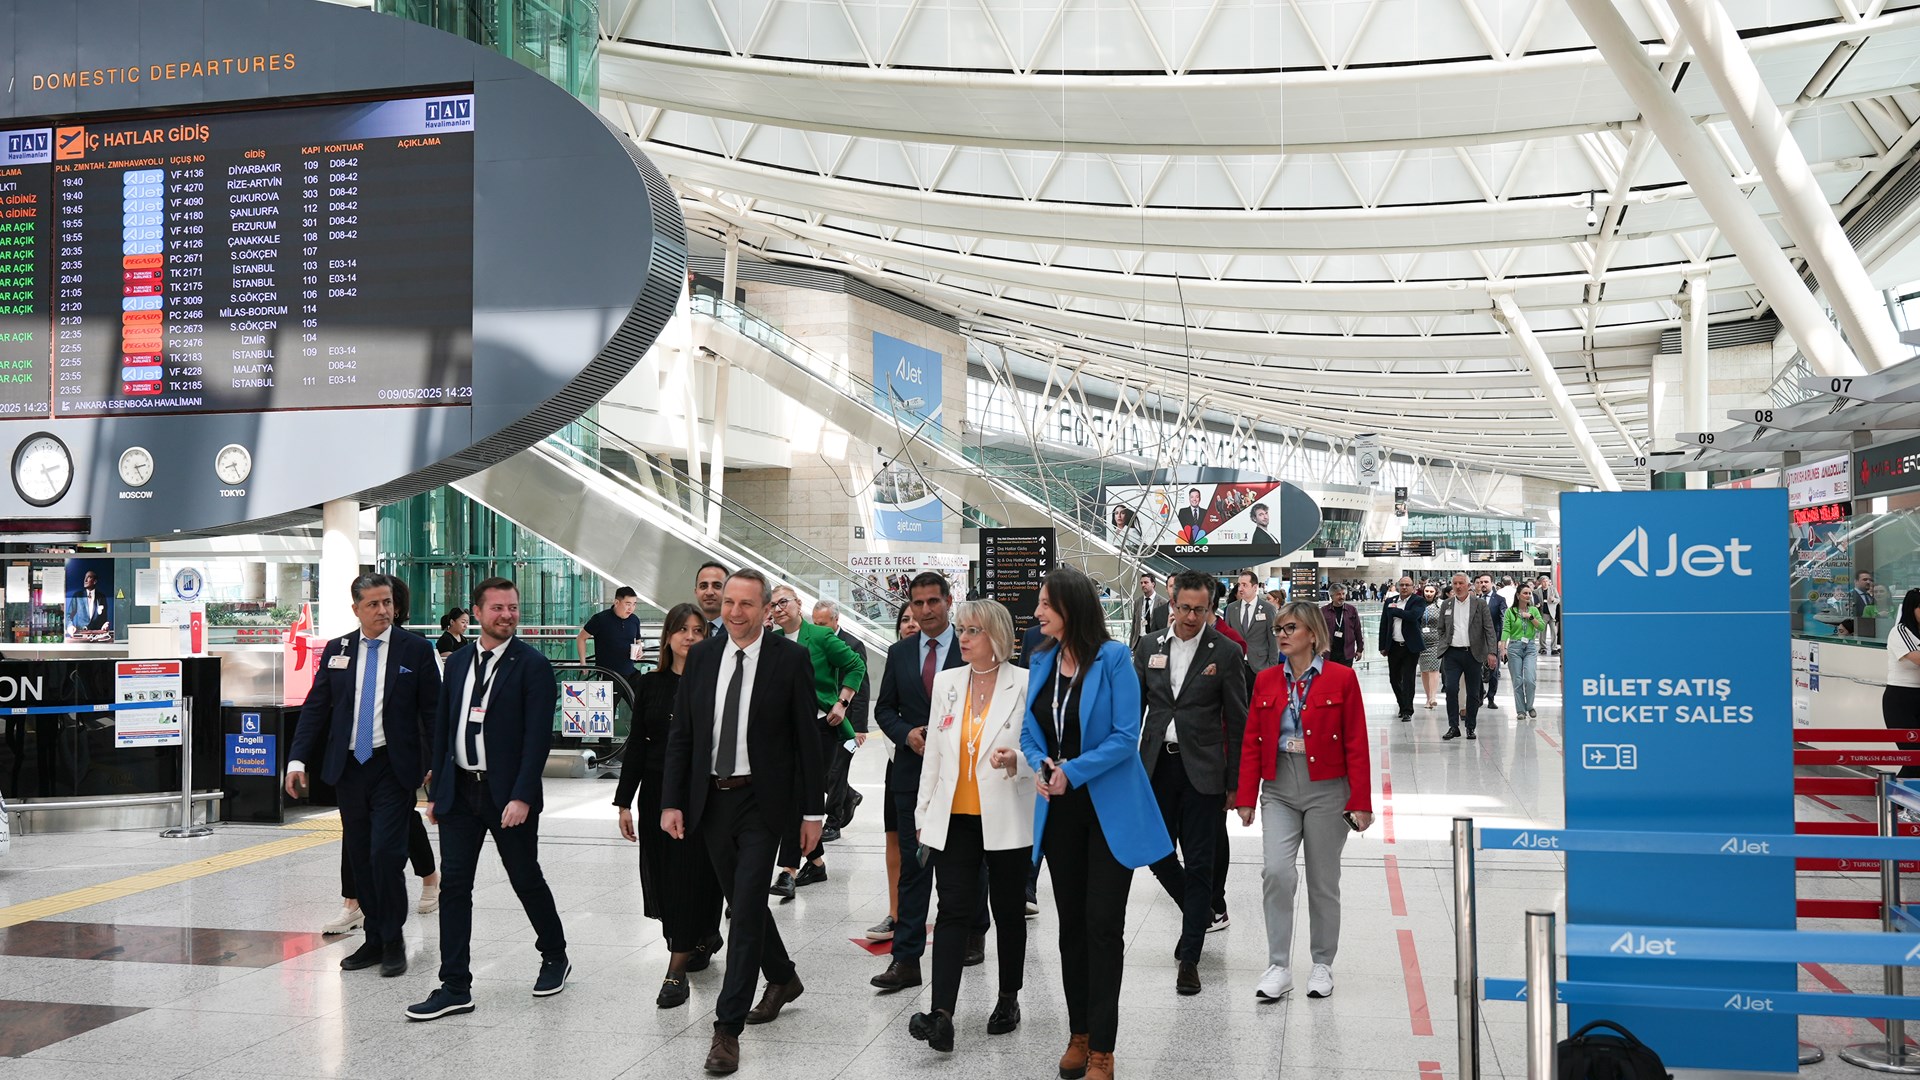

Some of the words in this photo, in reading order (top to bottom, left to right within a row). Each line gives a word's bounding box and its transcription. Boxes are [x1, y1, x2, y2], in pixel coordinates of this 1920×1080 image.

[33, 67, 140, 91] DOMESTIC
[150, 53, 296, 81] DEPARTURES
[425, 99, 470, 121] TAV
[425, 119, 471, 129] Havalimanları
[9, 133, 48, 153] TAV
[85, 133, 99, 151] İÇ
[104, 129, 164, 147] HATLAR
[168, 124, 209, 143] GİDİŞ
[8, 151, 48, 160] Havalimanları
[56, 163, 72, 173] PLN.
[170, 155, 192, 165] UÇUŞ
[193, 154, 206, 163] NO
[244, 149, 266, 159] GİDİŞ
[302, 146, 321, 155] KAPI
[324, 143, 364, 153] KONTUAR
[398, 137, 441, 149] AÇIKLAMA
[63, 177, 83, 187] 19:40
[124, 171, 163, 184] AJet
[171, 170, 182, 179] VF
[184, 169, 204, 178] 4136
[228, 163, 281, 175] DİYARBAKIR
[304, 161, 319, 170] 109
[330, 158, 358, 168] D08-42
[62, 191, 83, 200] 19:40
[170, 184, 182, 193] VF
[184, 183, 204, 192] 4270
[227, 176, 282, 189] RİZE-ARTVİN
[304, 175, 318, 184] 106
[330, 172, 358, 182] D08-42
[62, 205, 83, 214] 19:45
[170, 198, 182, 207] VF
[183, 197, 203, 206] 4090
[230, 192, 279, 203] CUKUROVA
[303, 189, 318, 199] 303
[329, 187, 358, 197] D08-42
[62, 219, 83, 228] 19:55
[170, 212, 182, 221] VF
[183, 211, 203, 220] 4180
[230, 206, 279, 219] ŞANLIURFA
[304, 203, 318, 212] 112
[329, 201, 357, 211] D08-42
[62, 233, 83, 242] 19:55
[170, 226, 182, 235] VF
[183, 225, 203, 234] 4160
[232, 221, 276, 231] ERZURUM
[302, 218, 317, 227] 301
[329, 215, 357, 225] D08-42
[61, 246, 83, 256] 20:35
[170, 240, 182, 249] VF
[183, 239, 203, 248] 4126
[228, 234, 280, 248] ÇANAKKALE
[303, 232, 318, 241] 108
[329, 230, 357, 240] D08-42
[61, 260, 82, 270] 20:35
[124, 256, 162, 266] PEGASUS
[170, 254, 182, 263] PC
[184, 253, 202, 263] 2671
[231, 249, 277, 260] S.GÖKÇEN
[303, 247, 318, 256] 107
[61, 274, 82, 284] 20:40
[170, 269, 181, 277] TK
[183, 268, 202, 277] 2171
[233, 264, 275, 274] İSTANBUL
[303, 261, 318, 270] 103
[329, 259, 357, 269] E03-14
[61, 288, 82, 297] 21:05
[170, 283, 181, 291] TK
[183, 281, 203, 291] 2175
[233, 278, 275, 288] İSTANBUL
[303, 275, 317, 284] 110
[329, 274, 356, 283] E03-14
[61, 302, 82, 311] 21:20
[123, 297, 162, 310] AJet
[169, 297, 181, 306] VF
[183, 296, 203, 305] 3009
[230, 292, 277, 303] S.GÖKÇEN
[303, 290, 317, 299] 106
[329, 288, 357, 297] D08-42
[60, 316, 82, 325] 21:20
[124, 313, 161, 322] PEGASUS
[169, 311, 181, 320] PC
[183, 310, 203, 319] 2466
[220, 306, 288, 317] MİLAS-BODRUM
[303, 304, 317, 313] 114
[60, 330, 82, 339] 22:35
[169, 325, 181, 334] PC
[183, 324, 203, 333] 2673
[230, 320, 277, 332] S.GÖKÇEN
[302, 319, 317, 328] 105
[60, 344, 82, 353] 22:55
[169, 339, 181, 348] PC
[183, 338, 203, 347] 2476
[241, 334, 265, 345] İZMİR
[302, 333, 317, 342] 104
[60, 358, 82, 367] 22:55
[169, 353, 181, 362] TK
[183, 352, 203, 362] 2183
[232, 350, 274, 359] İSTANBUL
[302, 347, 317, 356] 109
[329, 346, 356, 355] E03-14
[60, 371, 81, 381] 23:55
[123, 367, 162, 380] AJet
[169, 367, 181, 376] VF
[182, 366, 203, 376] 4228
[233, 364, 273, 374] MALATYA
[328, 360, 356, 370] D08-42
[895, 356, 922, 385] AJet
[60, 385, 81, 394] 23:55
[169, 382, 181, 390] TK
[182, 381, 202, 390] 2185
[232, 378, 274, 388] İSTANBUL
[303, 377, 315, 385] 111
[329, 375, 356, 384] E03-14
[387, 388, 442, 399] 09/05/2025
[445, 387, 472, 398] 14:23
[1831, 378, 1852, 393] 07
[24, 402, 48, 413] 14:23
[75, 400, 107, 409] ANKARA
[109, 399, 153, 408] ESENBOĞA
[154, 397, 202, 406] HAVALİMANI
[1754, 410, 1773, 423] 08
[1698, 433, 1715, 445] 09
[1634, 457, 1646, 467] 10
[119, 491, 153, 499] MOSCOW
[219, 489, 246, 498] TOKYO
[897, 519, 922, 533] ajet.com
[851, 557, 881, 565] GAZETE
[884, 557, 891, 565] &
[894, 556, 916, 565] TEKEL
[1597, 525, 1752, 577] AJet
[1582, 673, 1652, 697] BİLET
[1657, 678, 1731, 702] SATIŞ
[1582, 705, 1669, 723] TICKET
[1674, 705, 1754, 724] SALES
[238, 735, 264, 745] Engelli
[234, 746, 267, 756] Danışma
[236, 757, 265, 765] Disabled
[1512, 831, 1559, 848] AJet
[1720, 837, 1770, 854] AJet
[1610, 931, 1676, 955] AJet
[1724, 993, 1773, 1011] AJet
